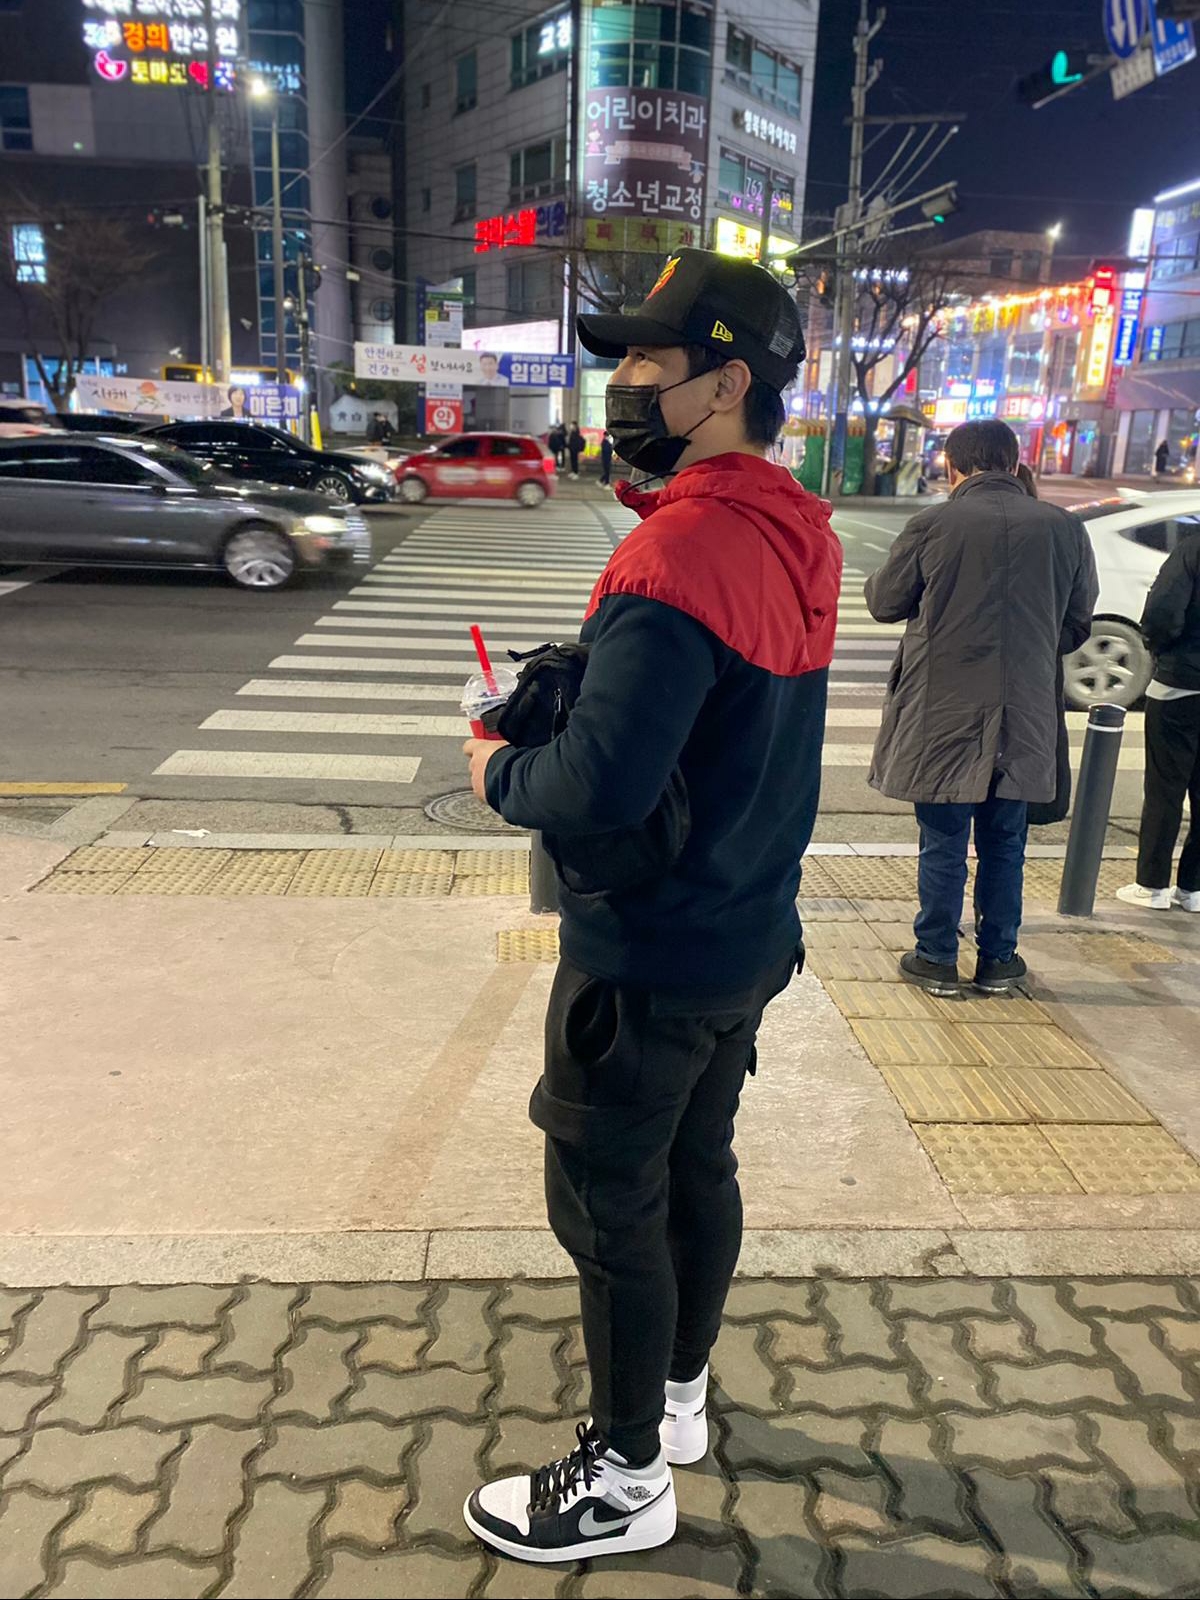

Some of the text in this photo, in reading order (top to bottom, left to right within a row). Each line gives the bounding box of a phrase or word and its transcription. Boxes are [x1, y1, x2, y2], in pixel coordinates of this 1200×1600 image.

[538, 15, 572, 54] 교정
[587, 95, 706, 138] 어린이치과
[586, 178, 702, 219] 청소년교정
[510, 363, 568, 386] 임일혁
[249, 396, 298, 417] 이은채
[436, 410, 452, 426] 약
